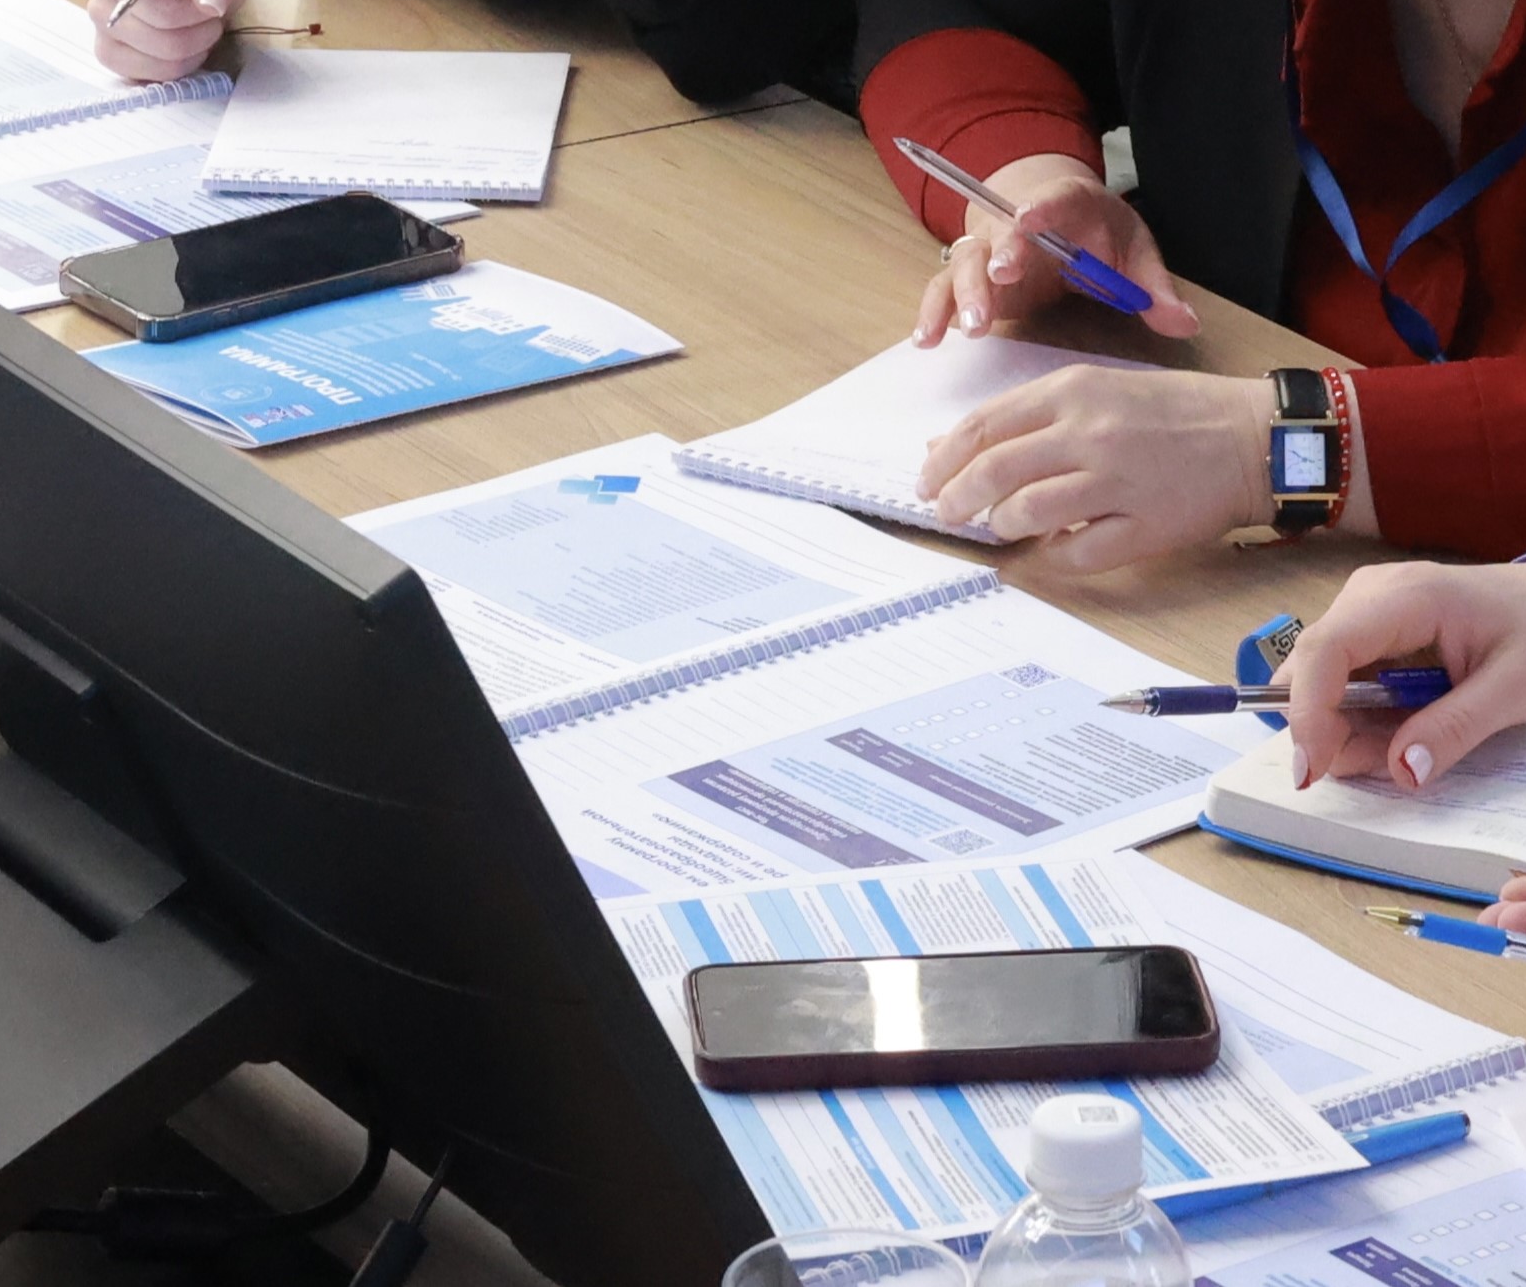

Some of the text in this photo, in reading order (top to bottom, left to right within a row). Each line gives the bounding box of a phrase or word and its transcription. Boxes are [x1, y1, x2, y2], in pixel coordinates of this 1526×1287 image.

[219, 345, 363, 405] ПРОГРАММА
[606, 836, 687, 877] программу
[667, 835, 732, 868] подходы
